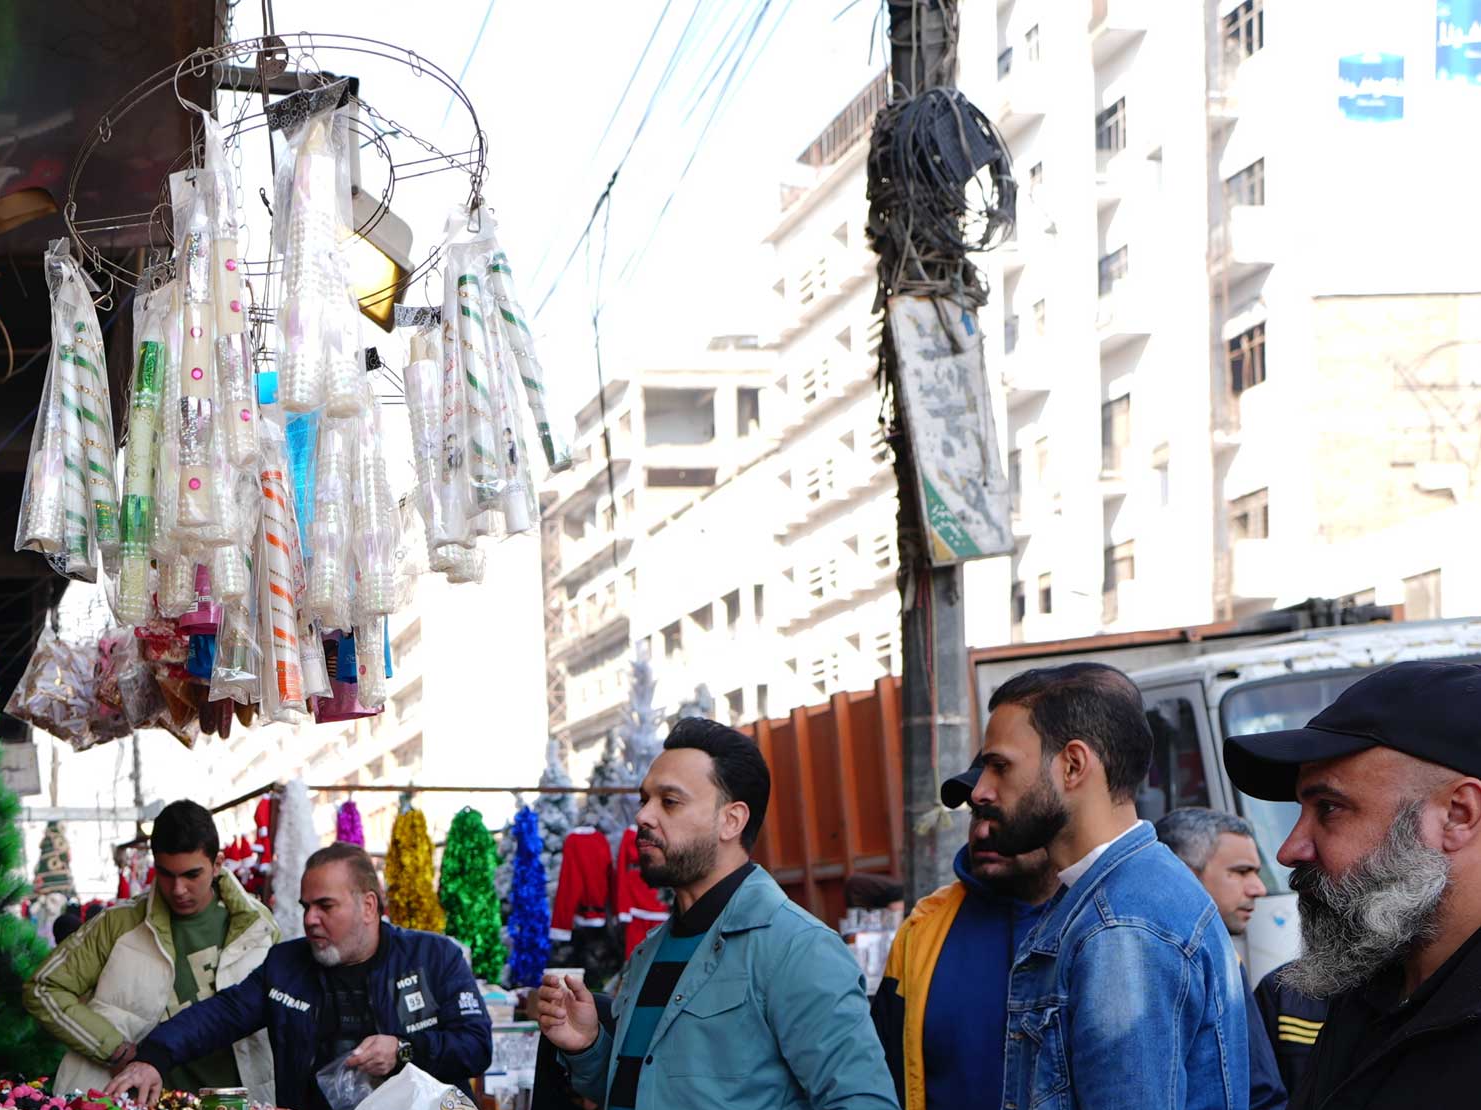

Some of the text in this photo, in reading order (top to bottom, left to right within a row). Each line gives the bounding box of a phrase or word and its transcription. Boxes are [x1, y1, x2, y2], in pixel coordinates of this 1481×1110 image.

[396, 974, 418, 990] HOT
[268, 987, 311, 1013] HOTRAW
[405, 1016, 438, 1034] FASHION
